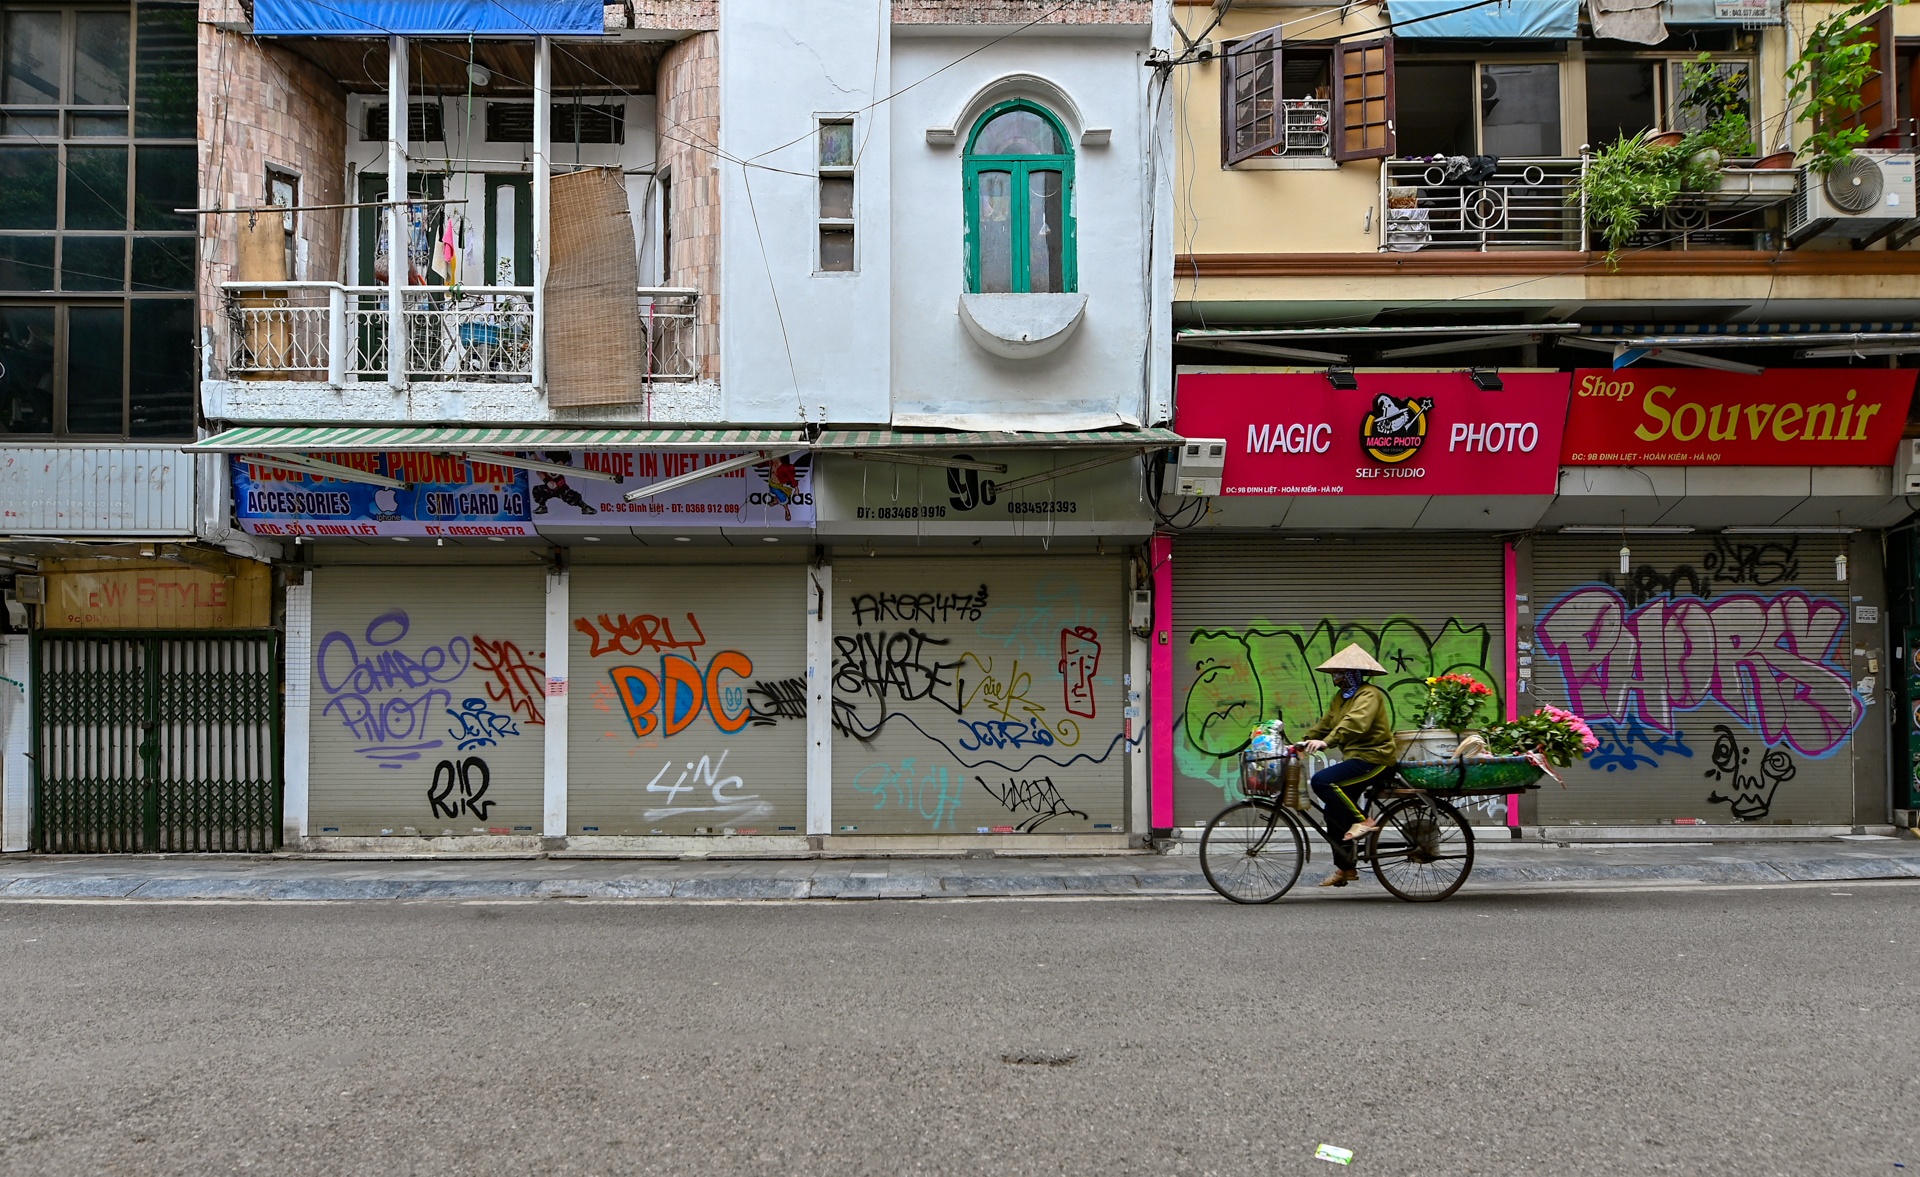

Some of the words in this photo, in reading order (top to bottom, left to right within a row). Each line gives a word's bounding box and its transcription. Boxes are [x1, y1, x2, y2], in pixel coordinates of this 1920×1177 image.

[1578, 375, 1634, 401] Shop
[1634, 385, 1881, 442] Souvenir
[1246, 423, 1332, 454] MAGIC
[1366, 437, 1392, 446] MAGIC
[1393, 437, 1421, 446] PHOTO
[1449, 422, 1539, 453] PHOTO
[583, 452, 634, 477] MADE
[639, 453, 658, 477] IN
[662, 453, 699, 477] VIET
[1693, 452, 1705, 460] HÀ
[1355, 467, 1381, 478] SELF
[1383, 467, 1426, 478] STUDIO
[1321, 485, 1331, 493] HÀ
[247, 491, 351, 515] ACCESSORIES
[426, 492, 456, 515] SIM
[460, 492, 499, 515] CARD
[503, 492, 524, 515] 4G
[600, 503, 614, 512] ĐC:
[616, 503, 627, 512] 9C
[671, 503, 684, 512] ĐT:
[685, 503, 705, 513] 0368
[707, 504, 722, 513] 912
[724, 504, 740, 513] 089
[1007, 501, 1077, 513] 0834523393
[306, 525, 317, 534] 9
[317, 525, 351, 535] ĐINH
[608, 650, 754, 740] BDC
